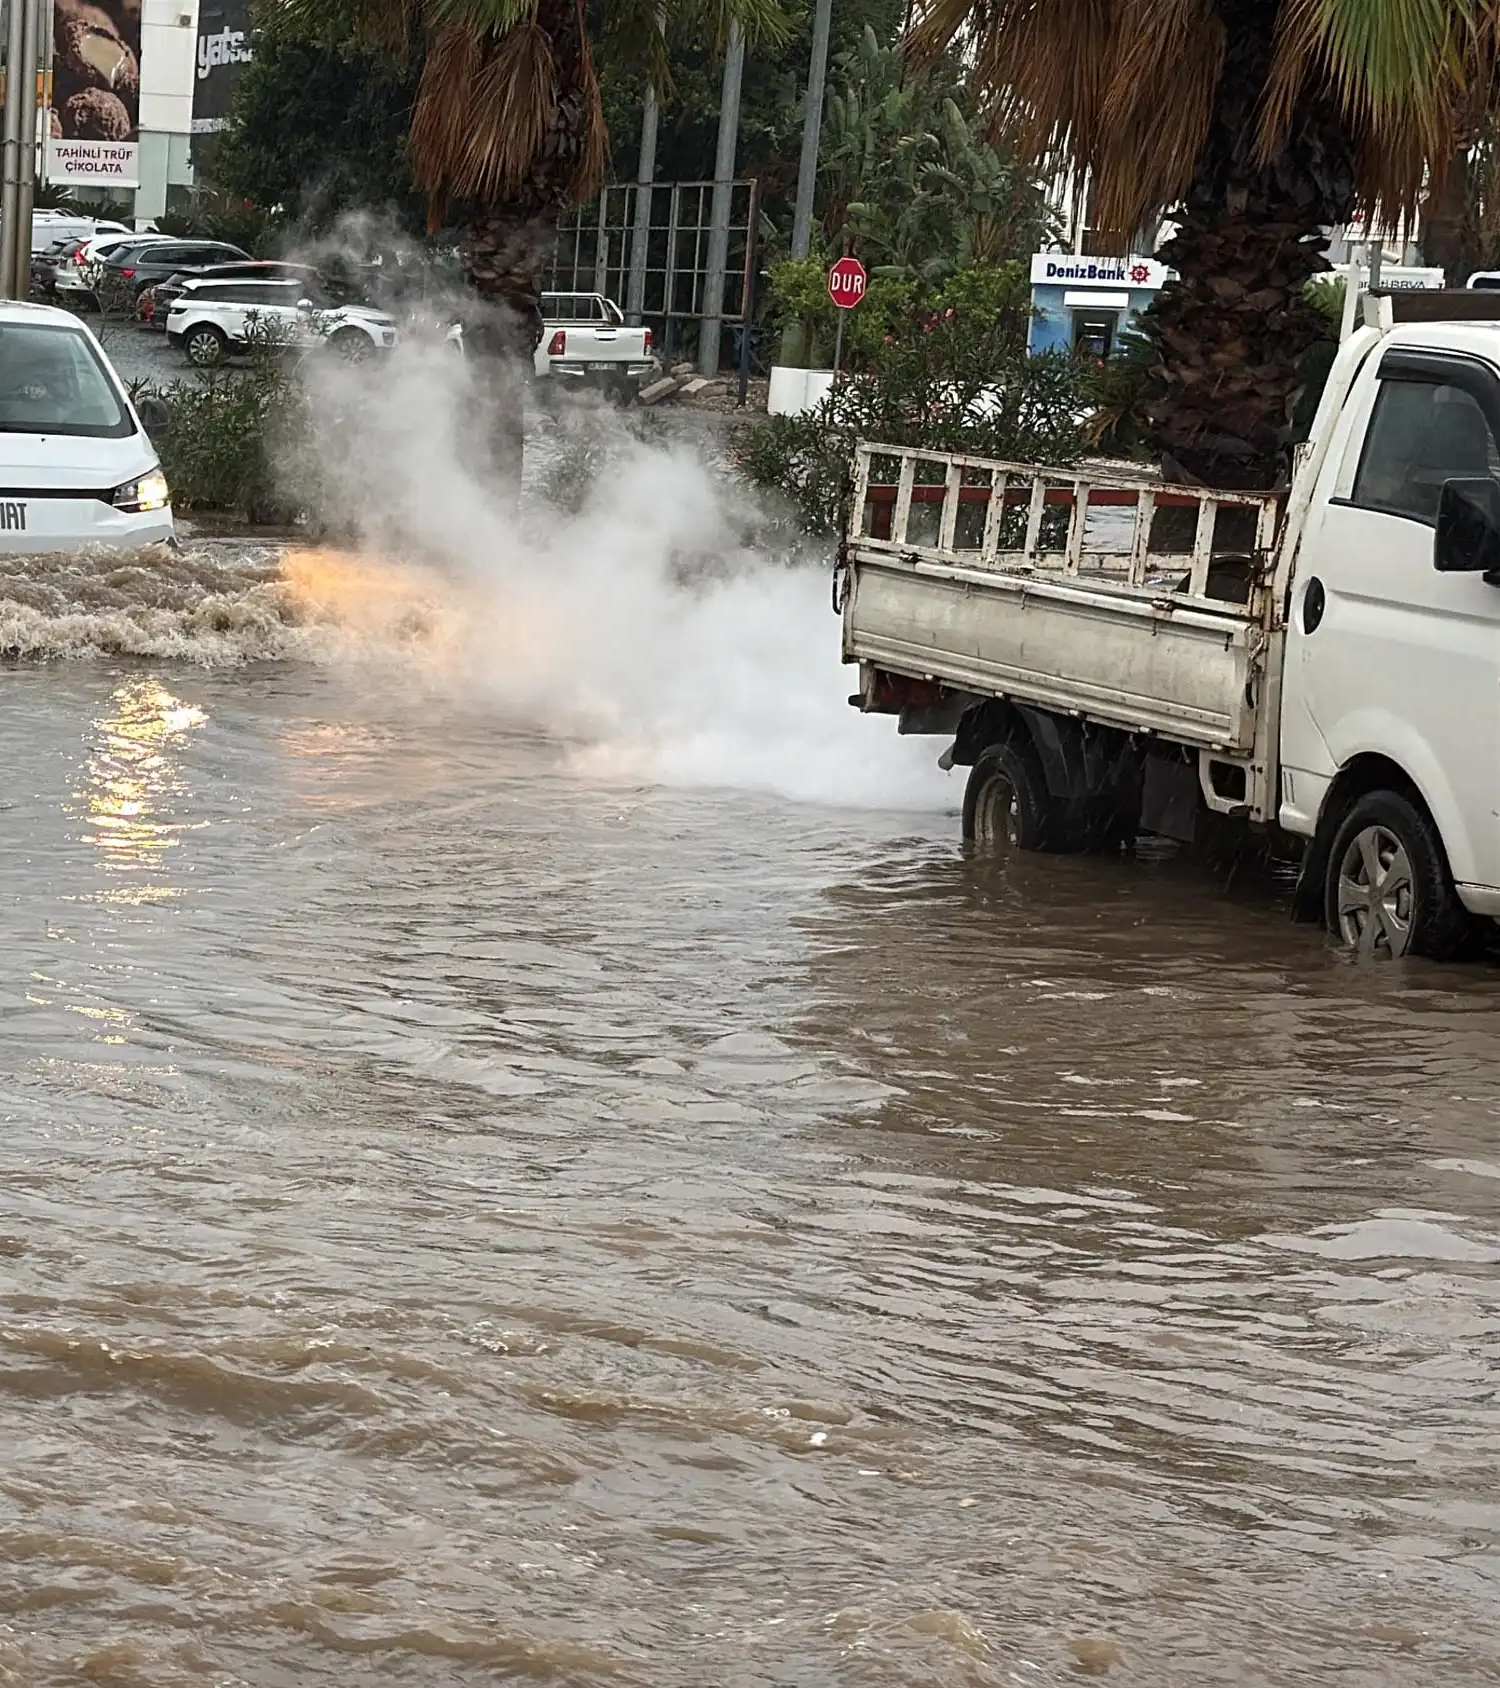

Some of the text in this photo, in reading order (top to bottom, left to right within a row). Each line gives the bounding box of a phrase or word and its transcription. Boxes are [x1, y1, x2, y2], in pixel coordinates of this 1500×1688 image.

[55, 145, 133, 161] TAHİNLİ TRÜF
[65, 159, 123, 174] ÇİKOLATA
[1046, 262, 1126, 281] DenizBank
[831, 272, 863, 294] DUR
[1390, 279, 1426, 289] BBVA
